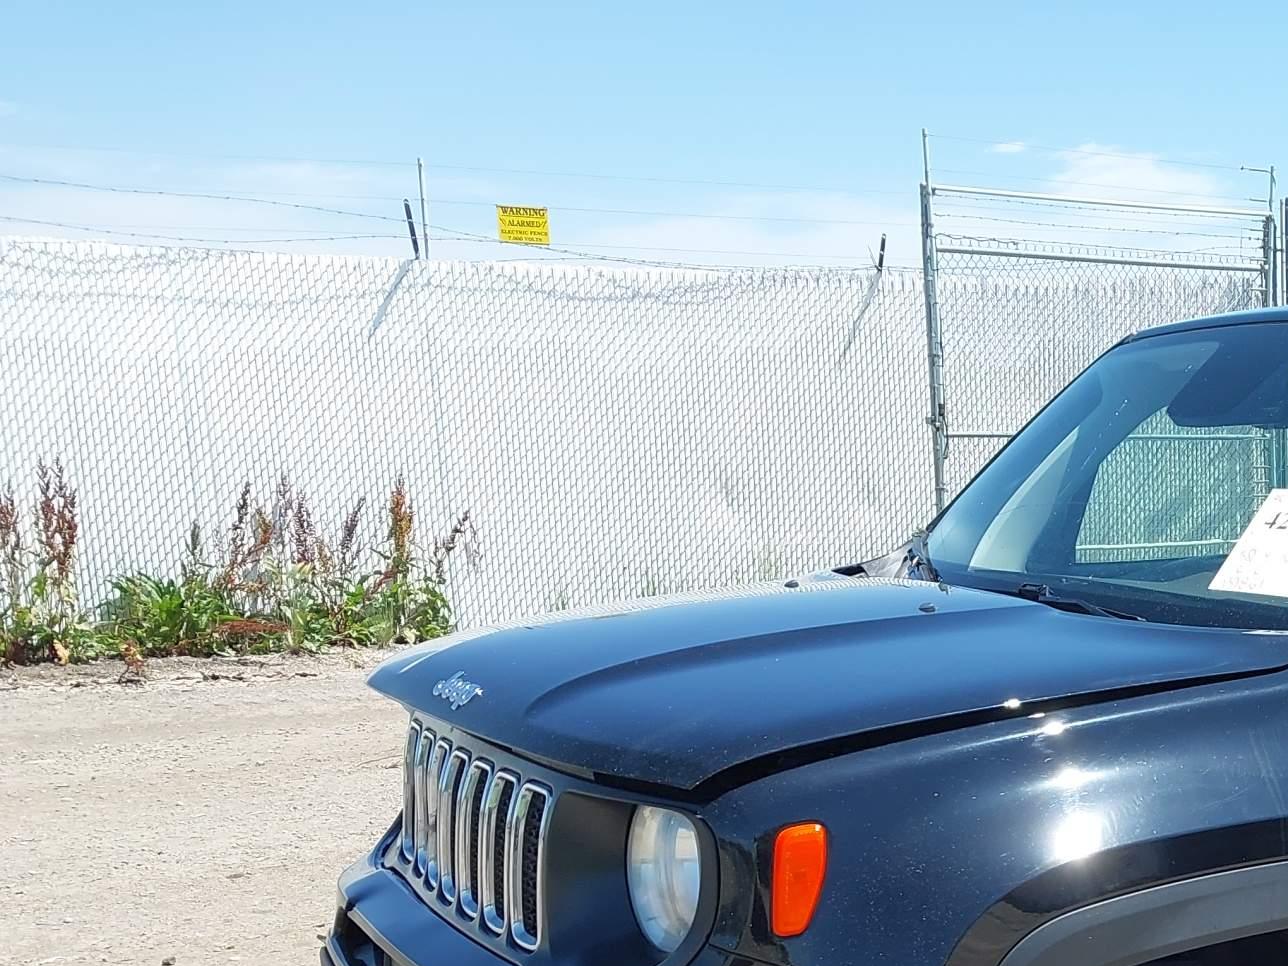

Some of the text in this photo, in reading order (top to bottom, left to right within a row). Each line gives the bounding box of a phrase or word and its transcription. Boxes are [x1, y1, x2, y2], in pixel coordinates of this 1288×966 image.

[500, 206, 545, 217] WARNING
[508, 220, 541, 228] ALARMED
[432, 670, 484, 711] Jeep
